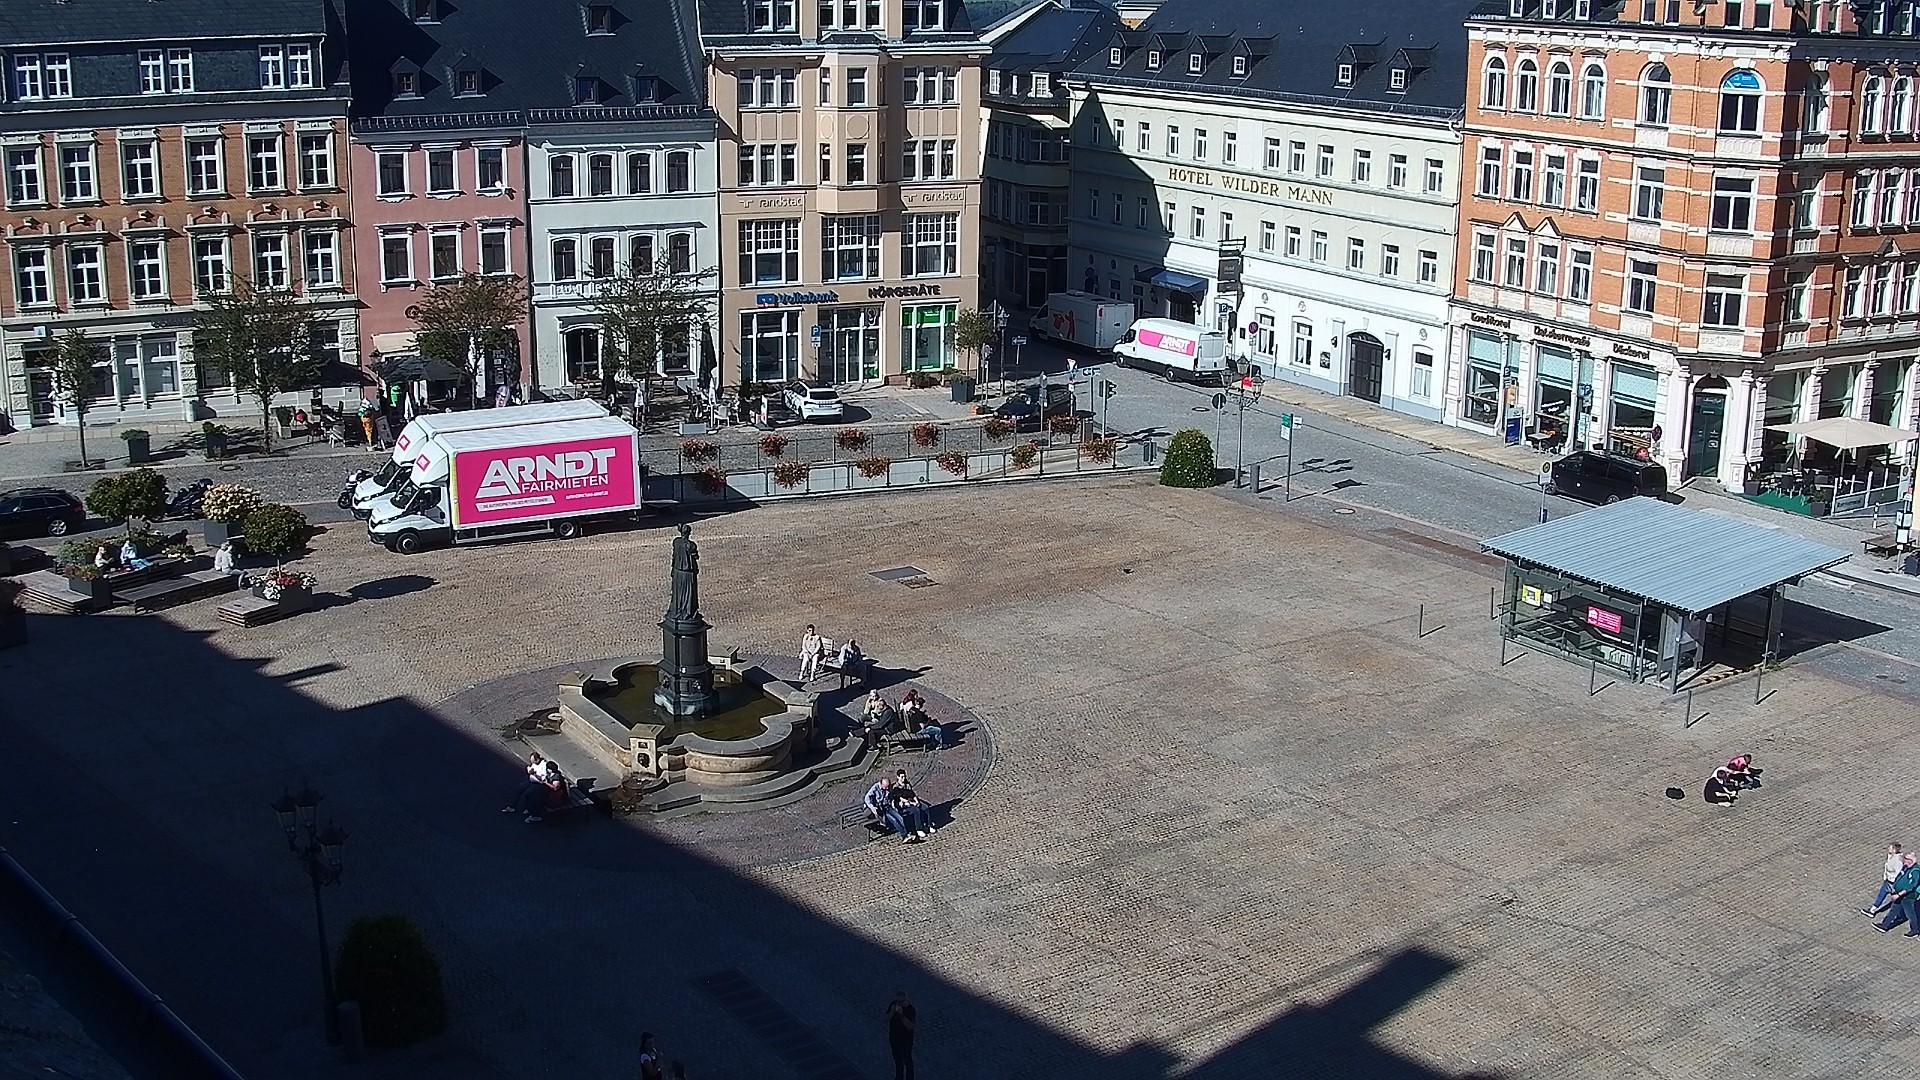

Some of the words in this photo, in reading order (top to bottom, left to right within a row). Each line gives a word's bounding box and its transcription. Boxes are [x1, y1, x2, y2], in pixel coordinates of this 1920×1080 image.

[1168, 167, 1213, 186] HOTEL
[1221, 175, 1280, 197] WILDER
[1287, 186, 1334, 206] MANN
[759, 195, 804, 208] randstad
[922, 190, 964, 202] randstad
[777, 290, 840, 305] Volksbank
[868, 284, 942, 299] HÖRGERÄTE
[1612, 343, 1651, 361] Bäckerei
[475, 448, 616, 499] ARNDT
[521, 474, 610, 494] FAIRMIETEN
